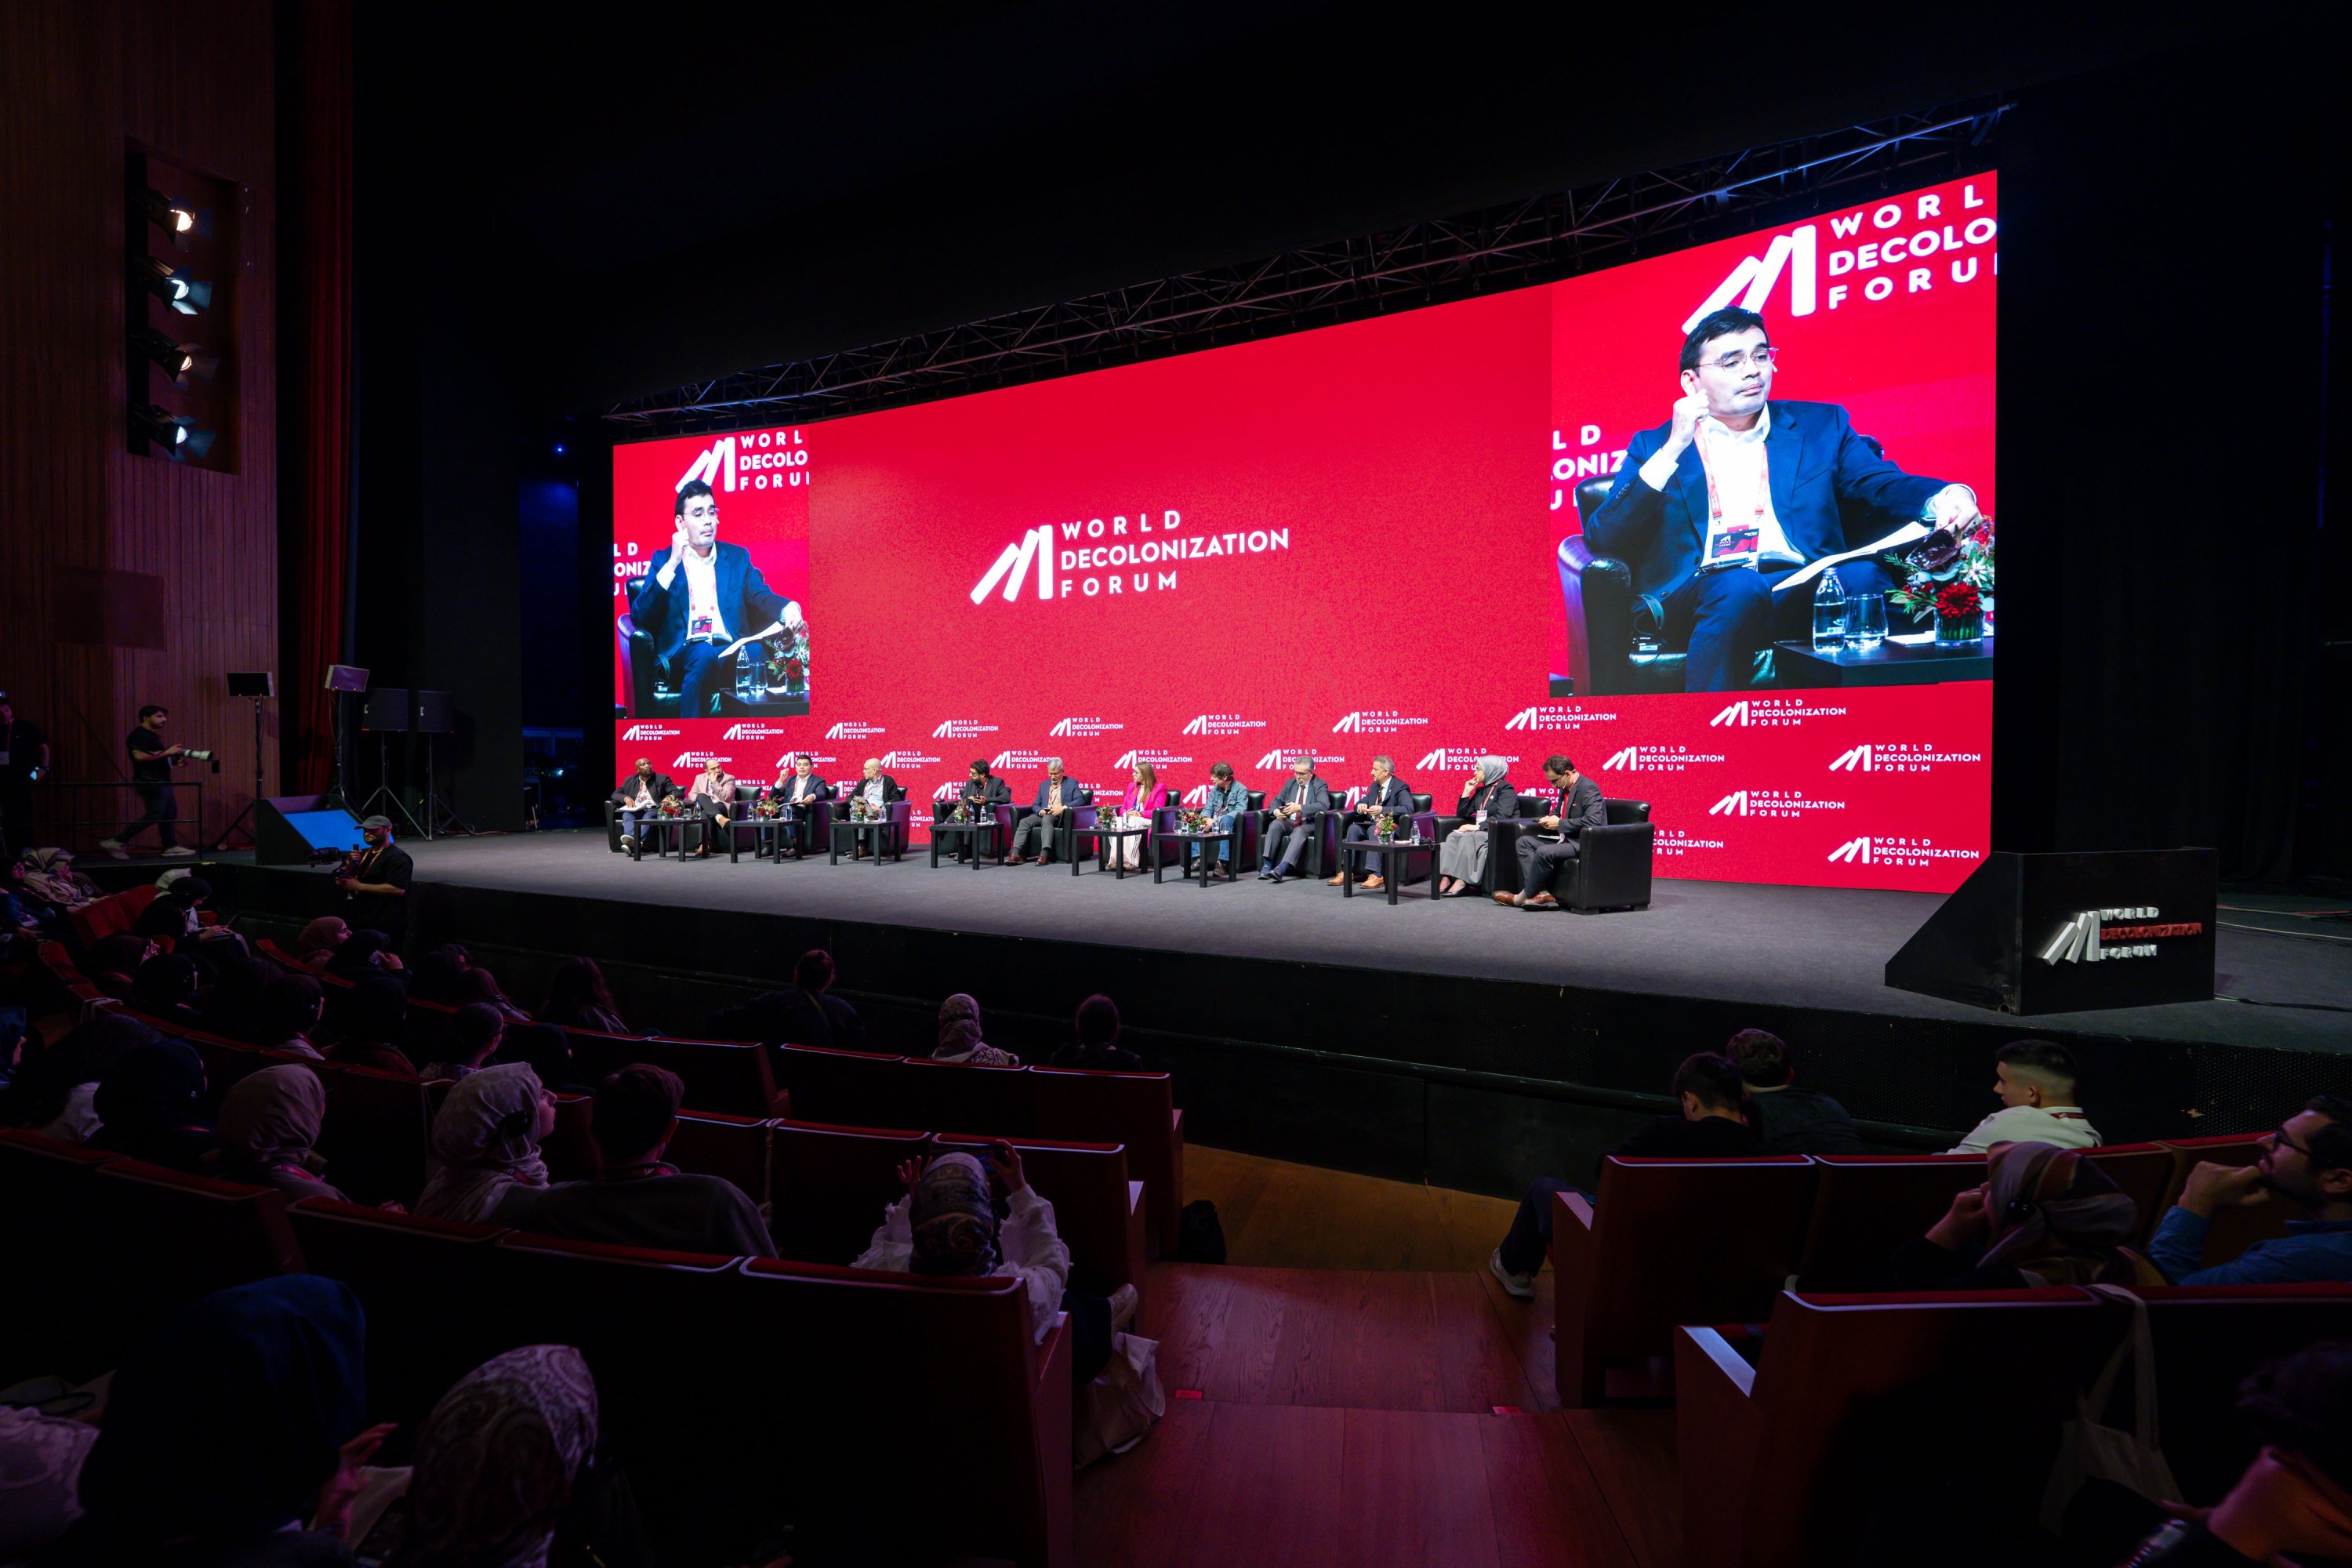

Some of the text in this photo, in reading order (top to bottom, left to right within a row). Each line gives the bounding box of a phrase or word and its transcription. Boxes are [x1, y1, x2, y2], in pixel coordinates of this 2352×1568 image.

[1828, 252, 1997, 310] FORU
[1062, 510, 1181, 540] WORLD
[1061, 528, 1289, 570] DECOLONIZATION
[1061, 571, 1177, 598] FORUM
[1539, 713, 1616, 722] DECOLONIZATION
[1751, 708, 1846, 717] DECOLONIZATION
[1750, 800, 1845, 809] DECOLONIZATION
[1653, 839, 1724, 848] COLONIZATION
[1875, 837, 1930, 846] WORLD
[1874, 847, 1979, 858] DECOLONIZATION
[1874, 857, 1929, 866] FORUM
[2100, 906, 2159, 921] WORLD
[2101, 922, 2202, 940] DECOLONIZATION
[2100, 944, 2157, 960] FORUM
